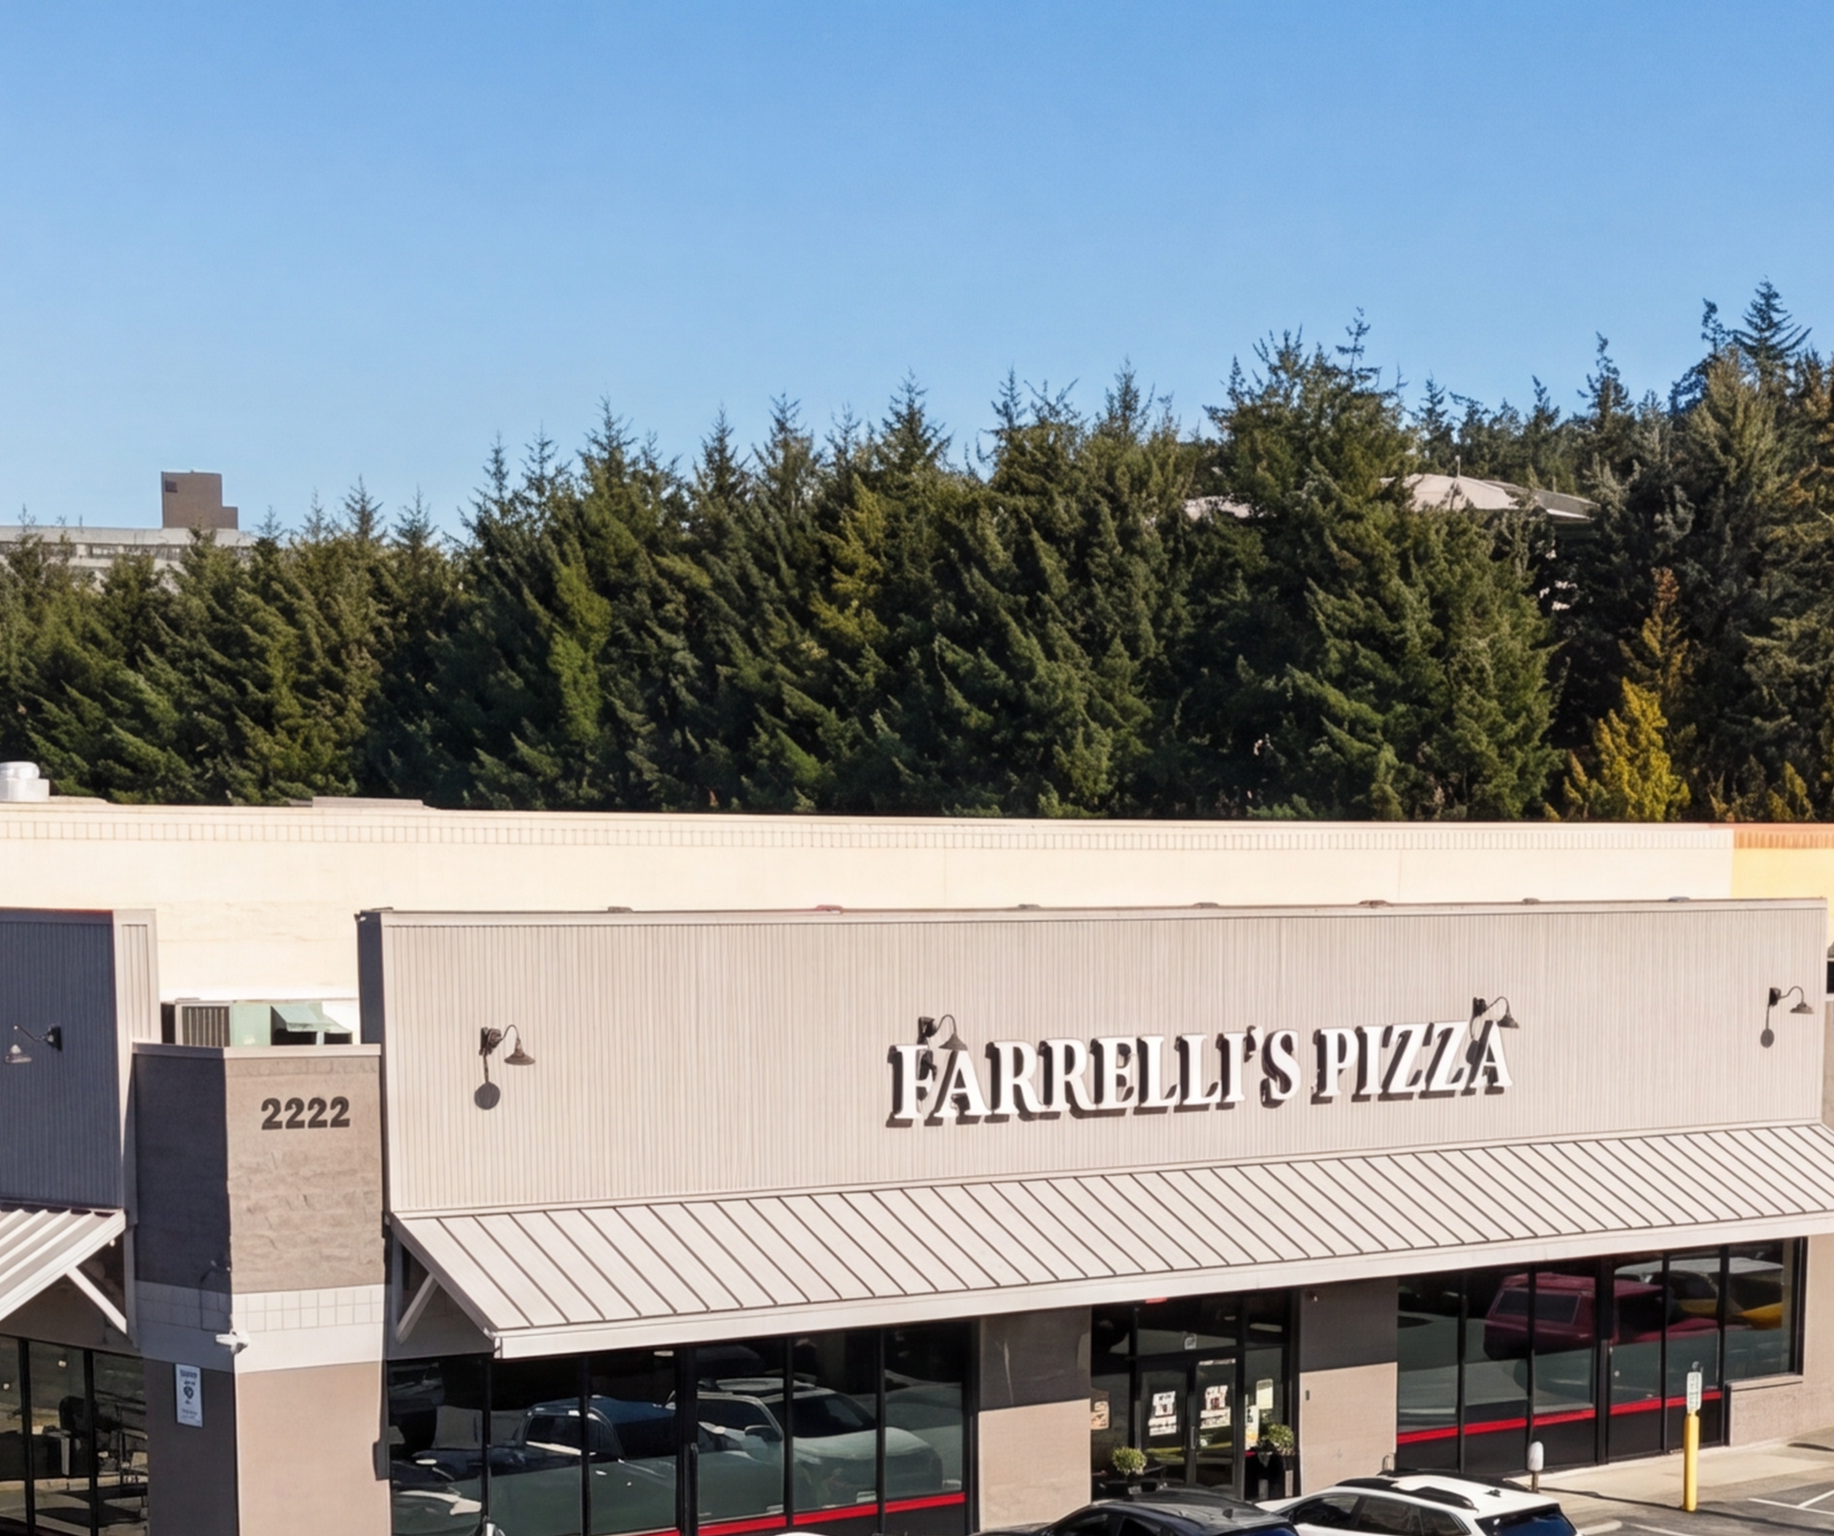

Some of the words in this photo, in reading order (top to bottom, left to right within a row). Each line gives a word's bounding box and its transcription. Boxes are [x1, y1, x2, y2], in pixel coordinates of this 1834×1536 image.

[889, 1027, 1302, 1122] FARRELLI'S
[1314, 1020, 1513, 1102] PIZZA
[261, 1096, 350, 1130] 2222
